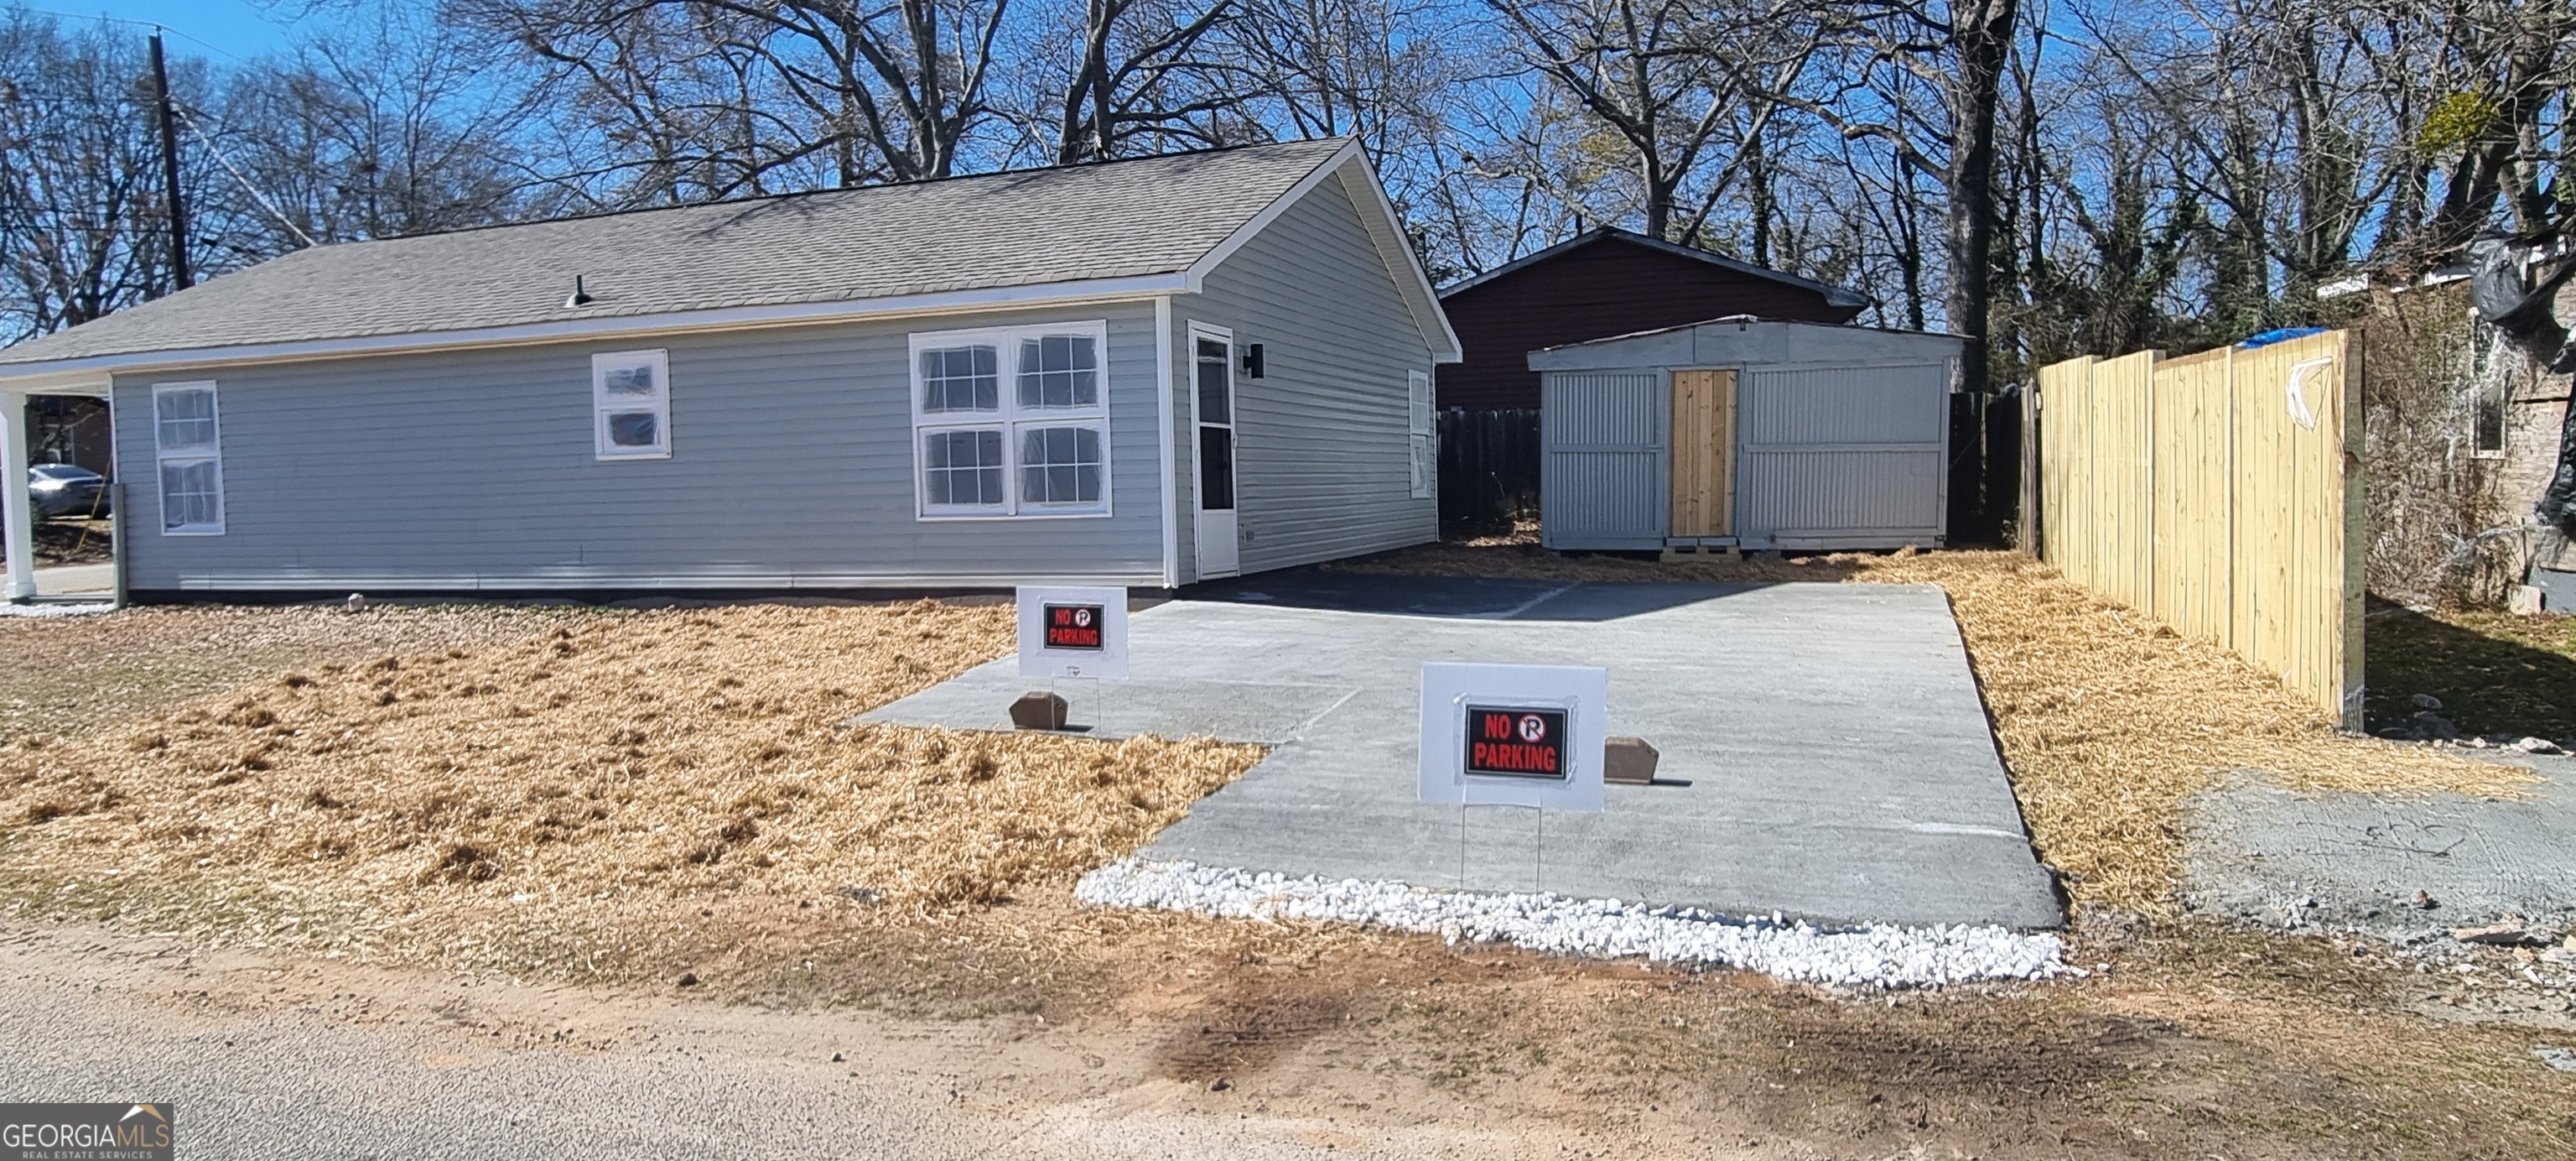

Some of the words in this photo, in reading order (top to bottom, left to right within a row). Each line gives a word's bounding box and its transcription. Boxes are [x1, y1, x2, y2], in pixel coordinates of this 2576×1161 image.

[1055, 609, 1071, 625] NO
[1049, 628, 1098, 645] PARKING
[1484, 714, 1511, 739] NO
[1474, 742, 1556, 771] PARKING
